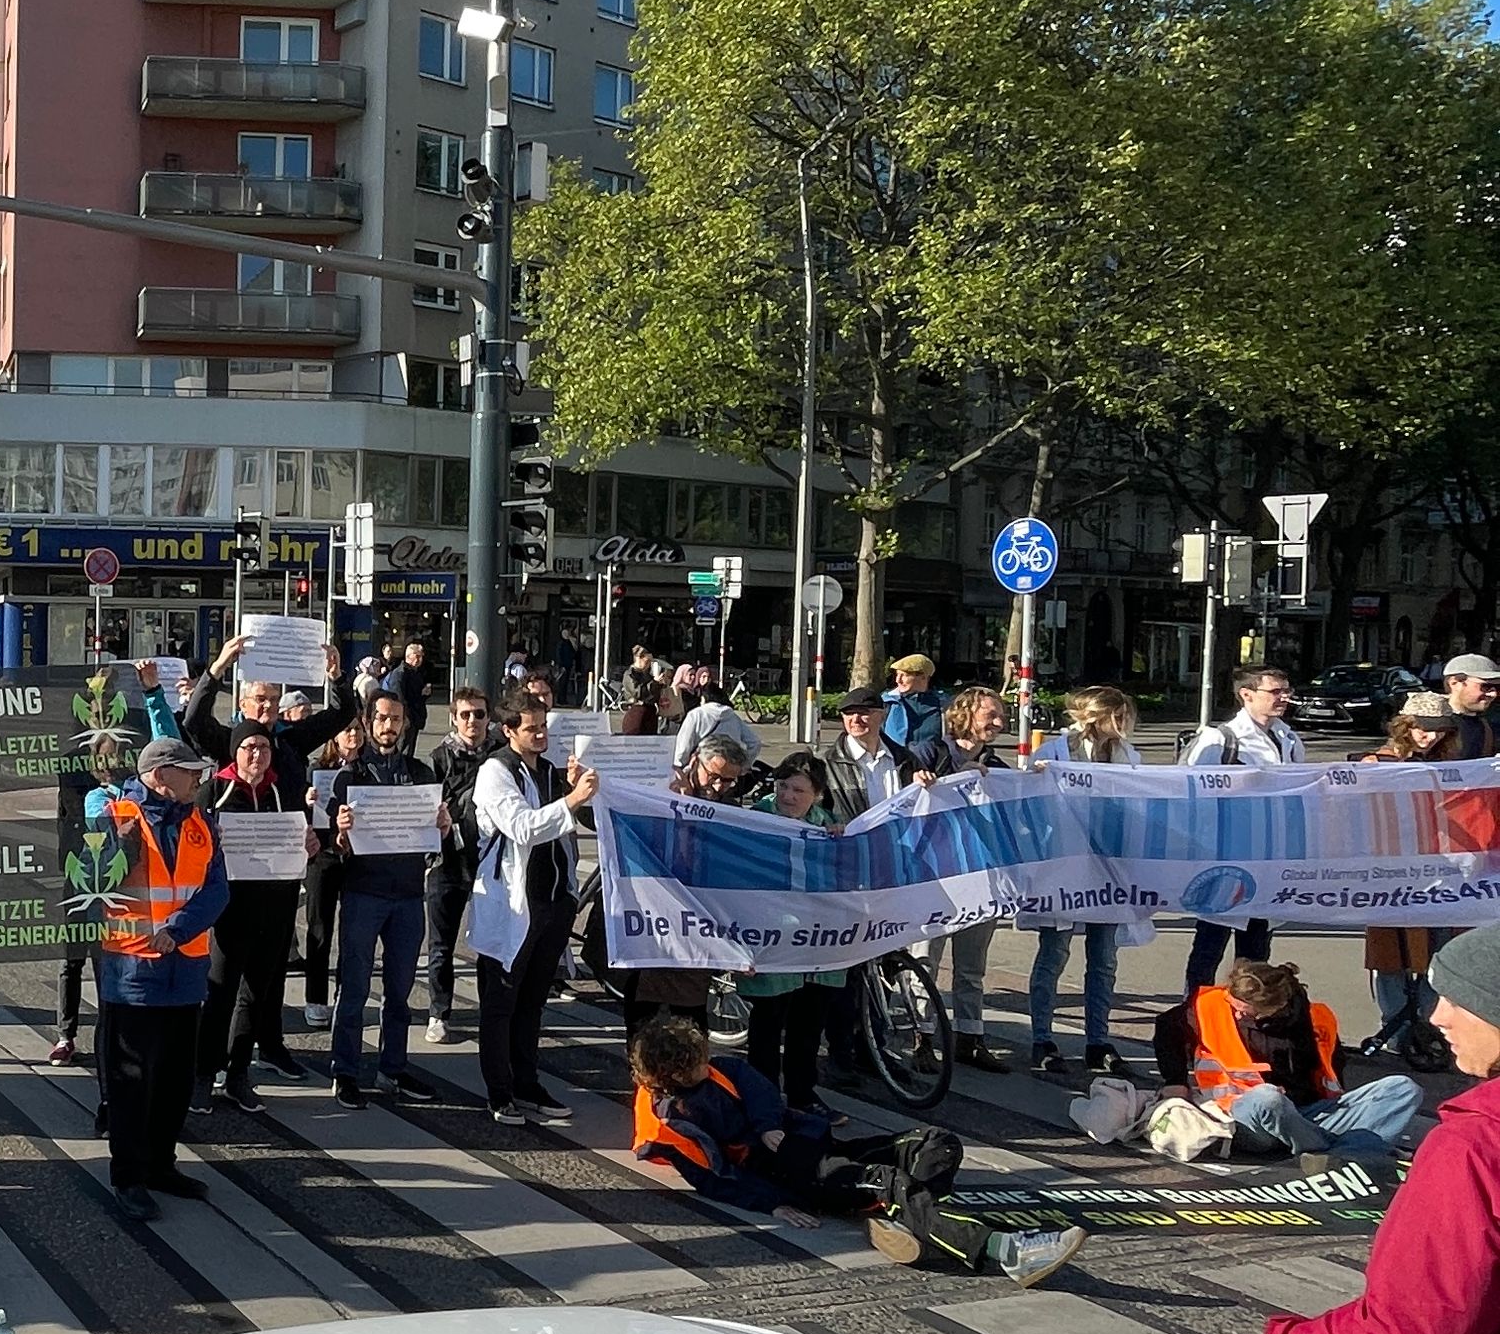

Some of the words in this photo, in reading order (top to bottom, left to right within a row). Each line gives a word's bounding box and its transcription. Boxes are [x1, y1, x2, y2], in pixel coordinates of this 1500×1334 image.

[133, 533, 203, 561] und
[381, 580, 406, 594] und
[409, 581, 446, 595] mehr
[1062, 772, 1093, 788] 1940
[1200, 774, 1232, 789] 1960
[1326, 770, 1357, 786] 1980
[623, 910, 670, 937] Die
[791, 923, 859, 946] sind
[1059, 883, 1169, 911] handeln.
